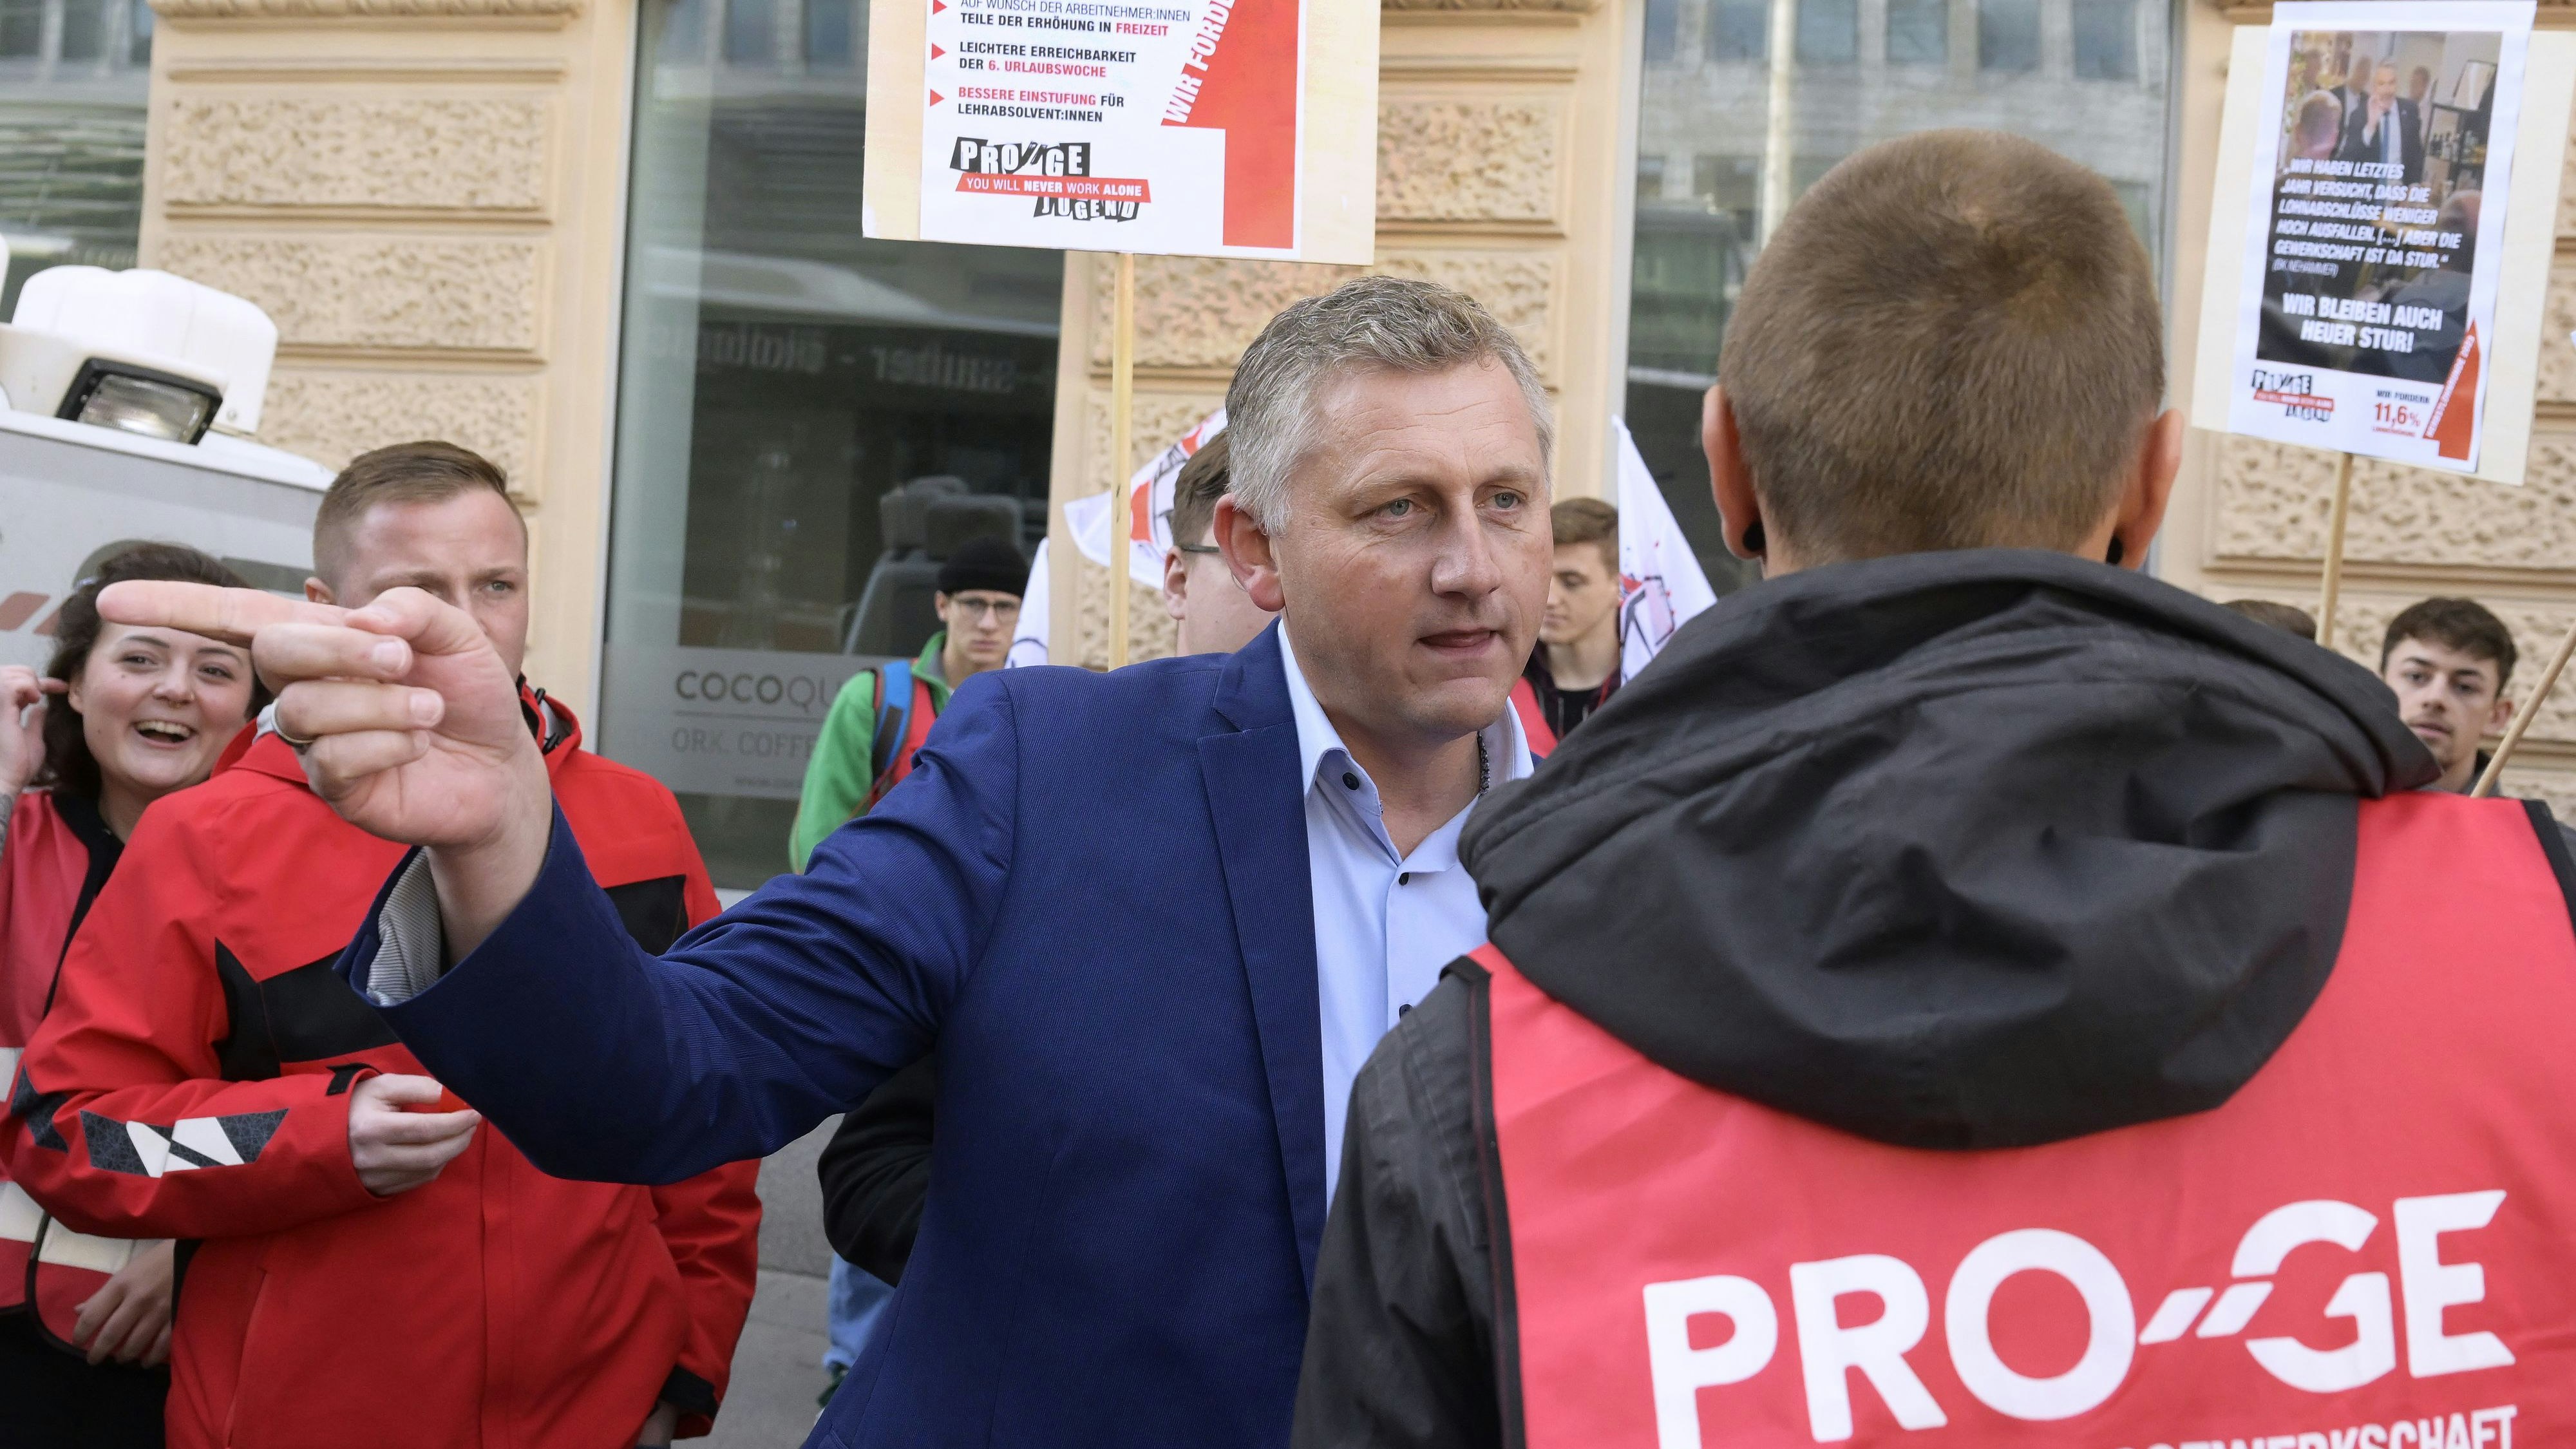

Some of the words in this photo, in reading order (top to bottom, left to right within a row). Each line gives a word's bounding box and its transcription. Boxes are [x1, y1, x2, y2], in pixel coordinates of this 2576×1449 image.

[961, 0, 982, 8] AUF
[1040, 1, 1063, 13] DER
[1065, 3, 1191, 22] ARBEITNEHMER:INNEN
[960, 13, 994, 26] TEILE
[998, 15, 1023, 27] DER
[1027, 15, 1095, 32] ERHÖHUNG
[1099, 21, 1112, 33] IN
[1116, 23, 1169, 37] FREIZEIT
[960, 41, 1026, 57] LEICHTERE
[1030, 45, 1137, 63] ERREICHBARKEIT
[959, 57, 984, 70] DER
[989, 59, 1000, 71] 6.
[1005, 61, 1106, 77] URLAUBSWOCHE
[958, 86, 1016, 101] BESSERE
[1019, 90, 1097, 106] EINSTUFUNG
[1101, 93, 1124, 108] FÜR
[1163, 72, 1203, 124] WIR
[958, 103, 1103, 122] LEHRABSOLVENT:INNEN
[2313, 160, 2354, 177] HABEN
[2353, 162, 2405, 180] LETZTES
[967, 177, 989, 190] YOU
[993, 178, 1020, 192] WILL
[1023, 180, 1063, 193] NEVER
[1066, 182, 1100, 194] WORK
[1103, 184, 1142, 196] ALONE
[2280, 178, 2313, 194] JAHR
[2313, 180, 2374, 201] VERSUCHT,
[2374, 185, 2408, 202] DASS
[2408, 187, 2432, 203] DIE
[1041, 196, 1137, 220] JUGEND
[2278, 198, 2383, 221] LOHNABSCHLÜSSE
[2383, 206, 2439, 225] WENIGER
[2276, 219, 2309, 236] HOCH
[2402, 229, 2439, 247] ABER
[2438, 232, 2463, 249] DIE
[2273, 239, 2365, 261] GEWERKSCHAFT
[2364, 247, 2387, 263] IST
[2387, 249, 2404, 265] DA
[2282, 292, 2316, 316] WIR
[2318, 296, 2391, 325] BLEIBEN
[2392, 305, 2443, 331] AUCH
[2300, 319, 2356, 346] HEUER
[2358, 327, 2415, 354] STUR!
[2374, 402, 2421, 428] 11,6%
